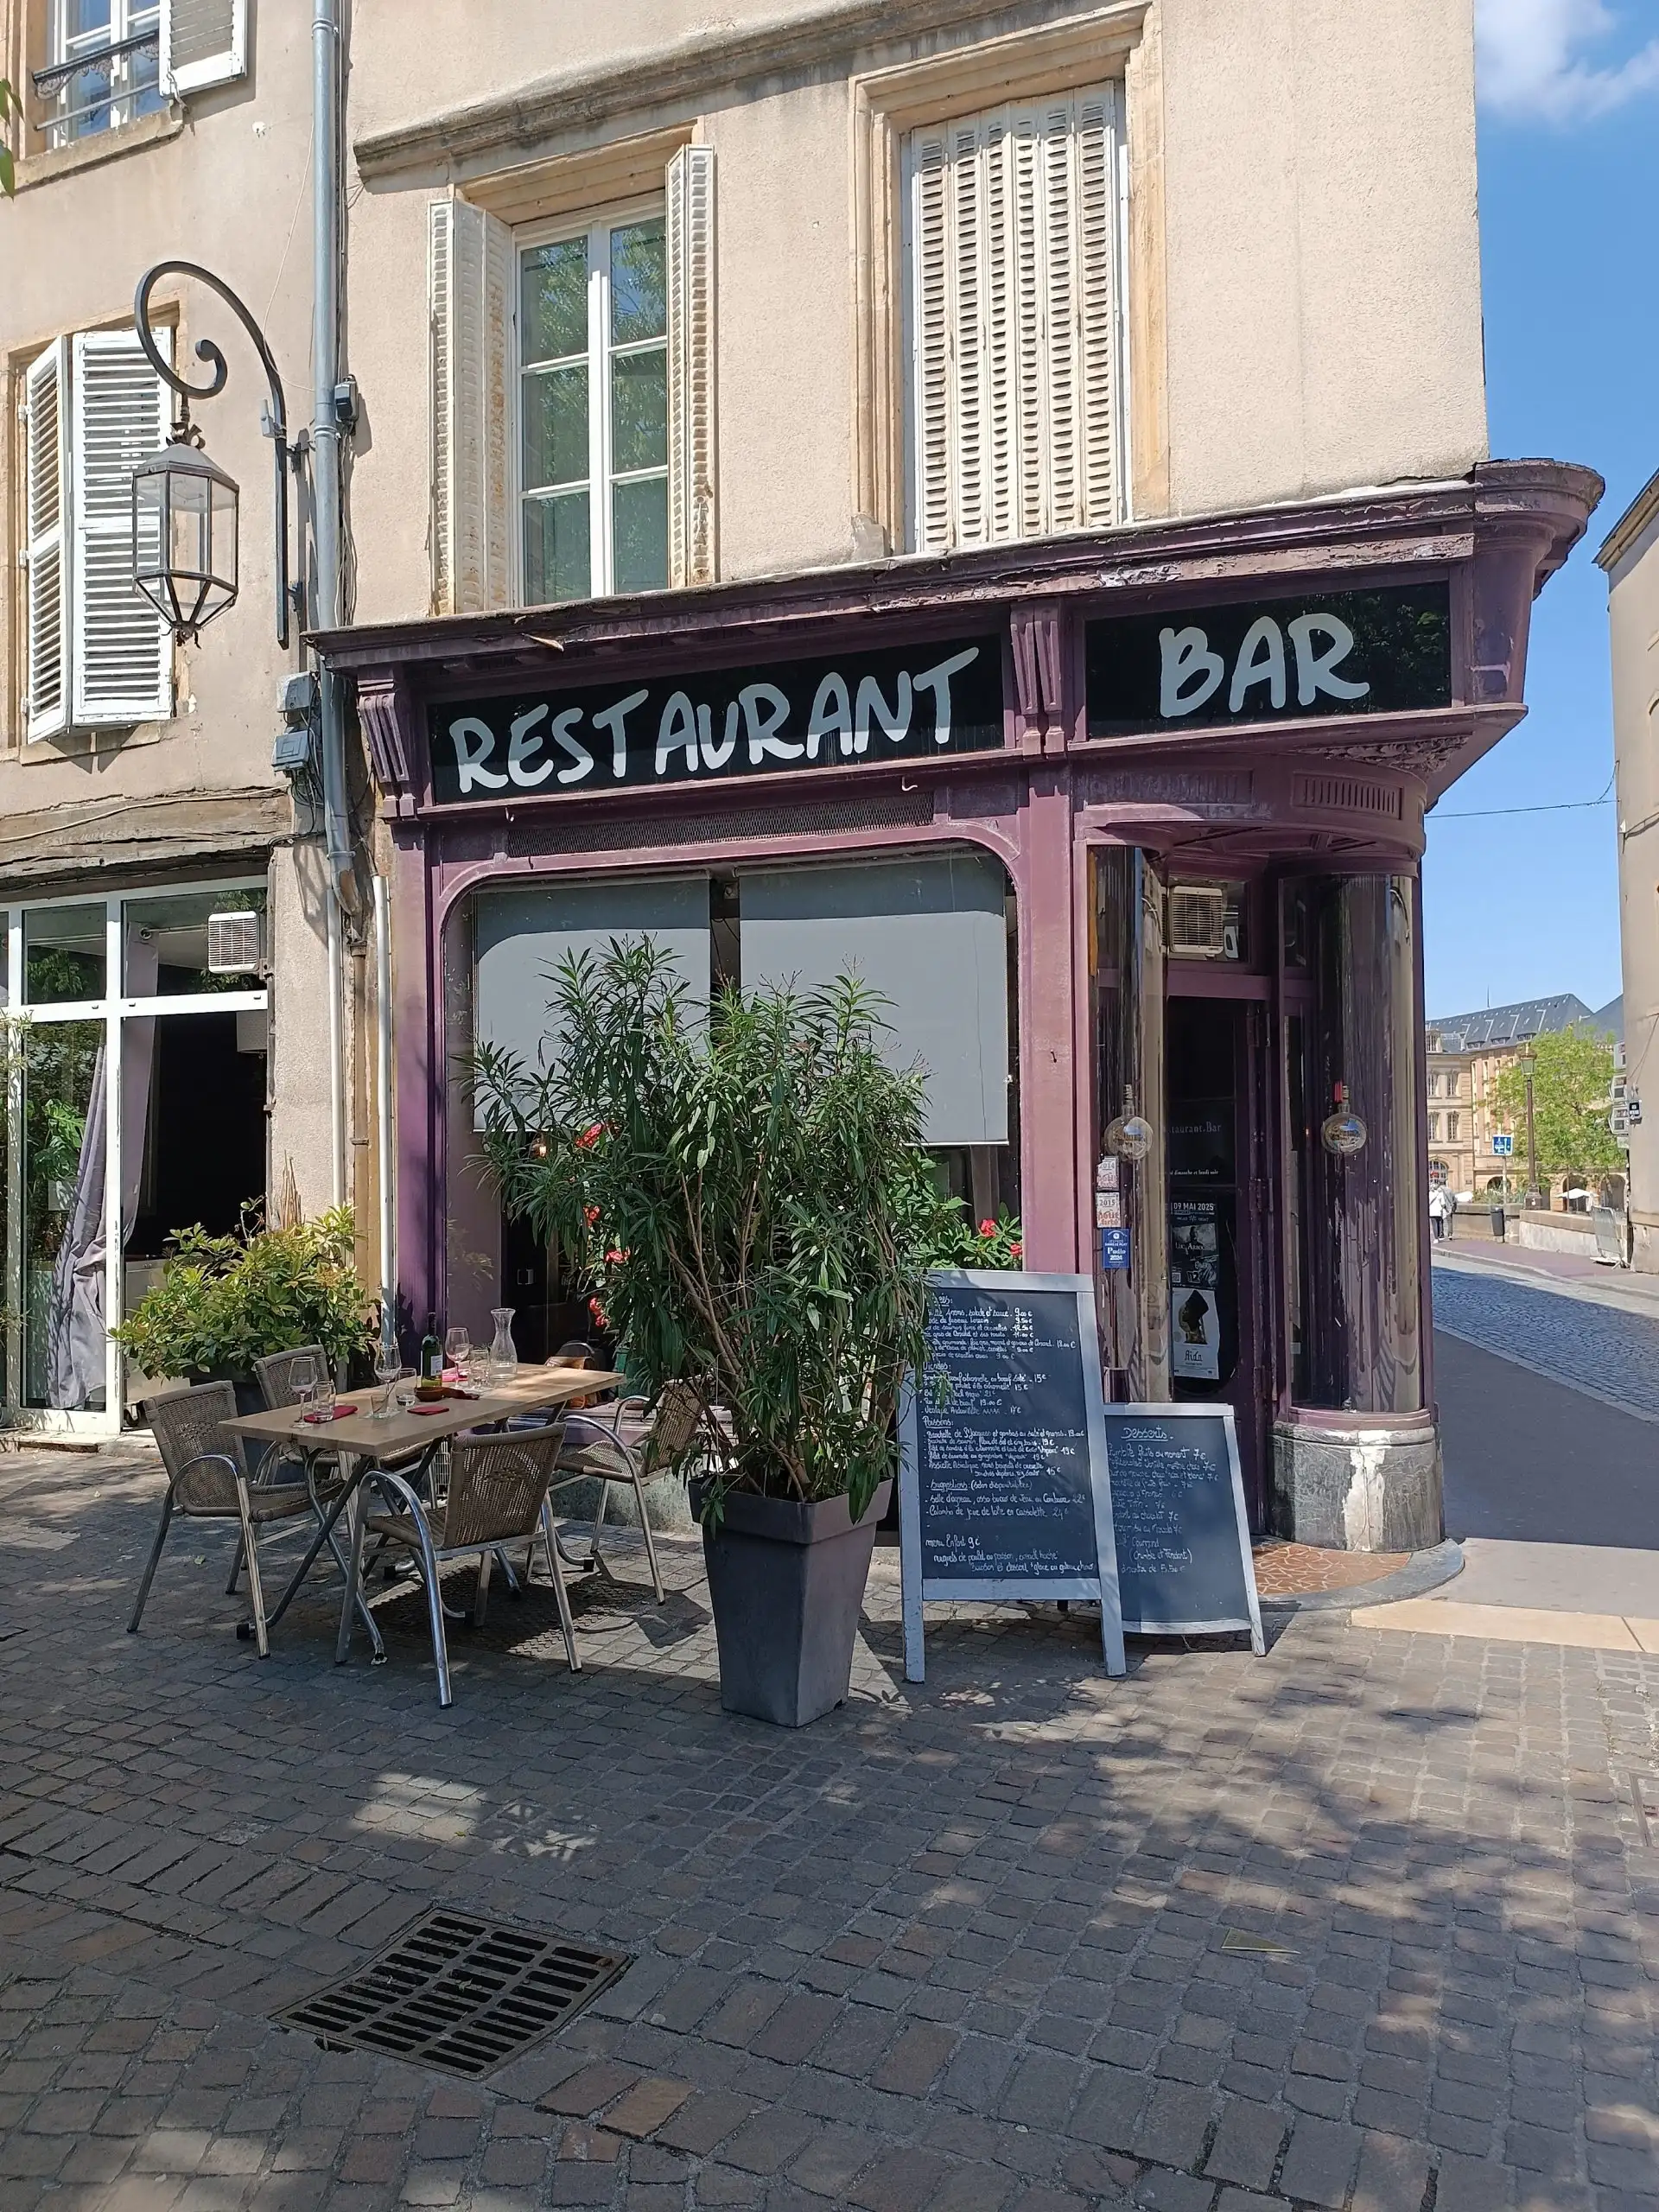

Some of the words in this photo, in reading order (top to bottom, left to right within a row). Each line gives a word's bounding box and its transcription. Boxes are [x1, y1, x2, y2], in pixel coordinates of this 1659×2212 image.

[1158, 613, 1370, 718] BAR
[448, 646, 980, 794] RESTAURANT
[1183, 1202, 1196, 1211] MAI
[1198, 1203, 1214, 1211] 2025
